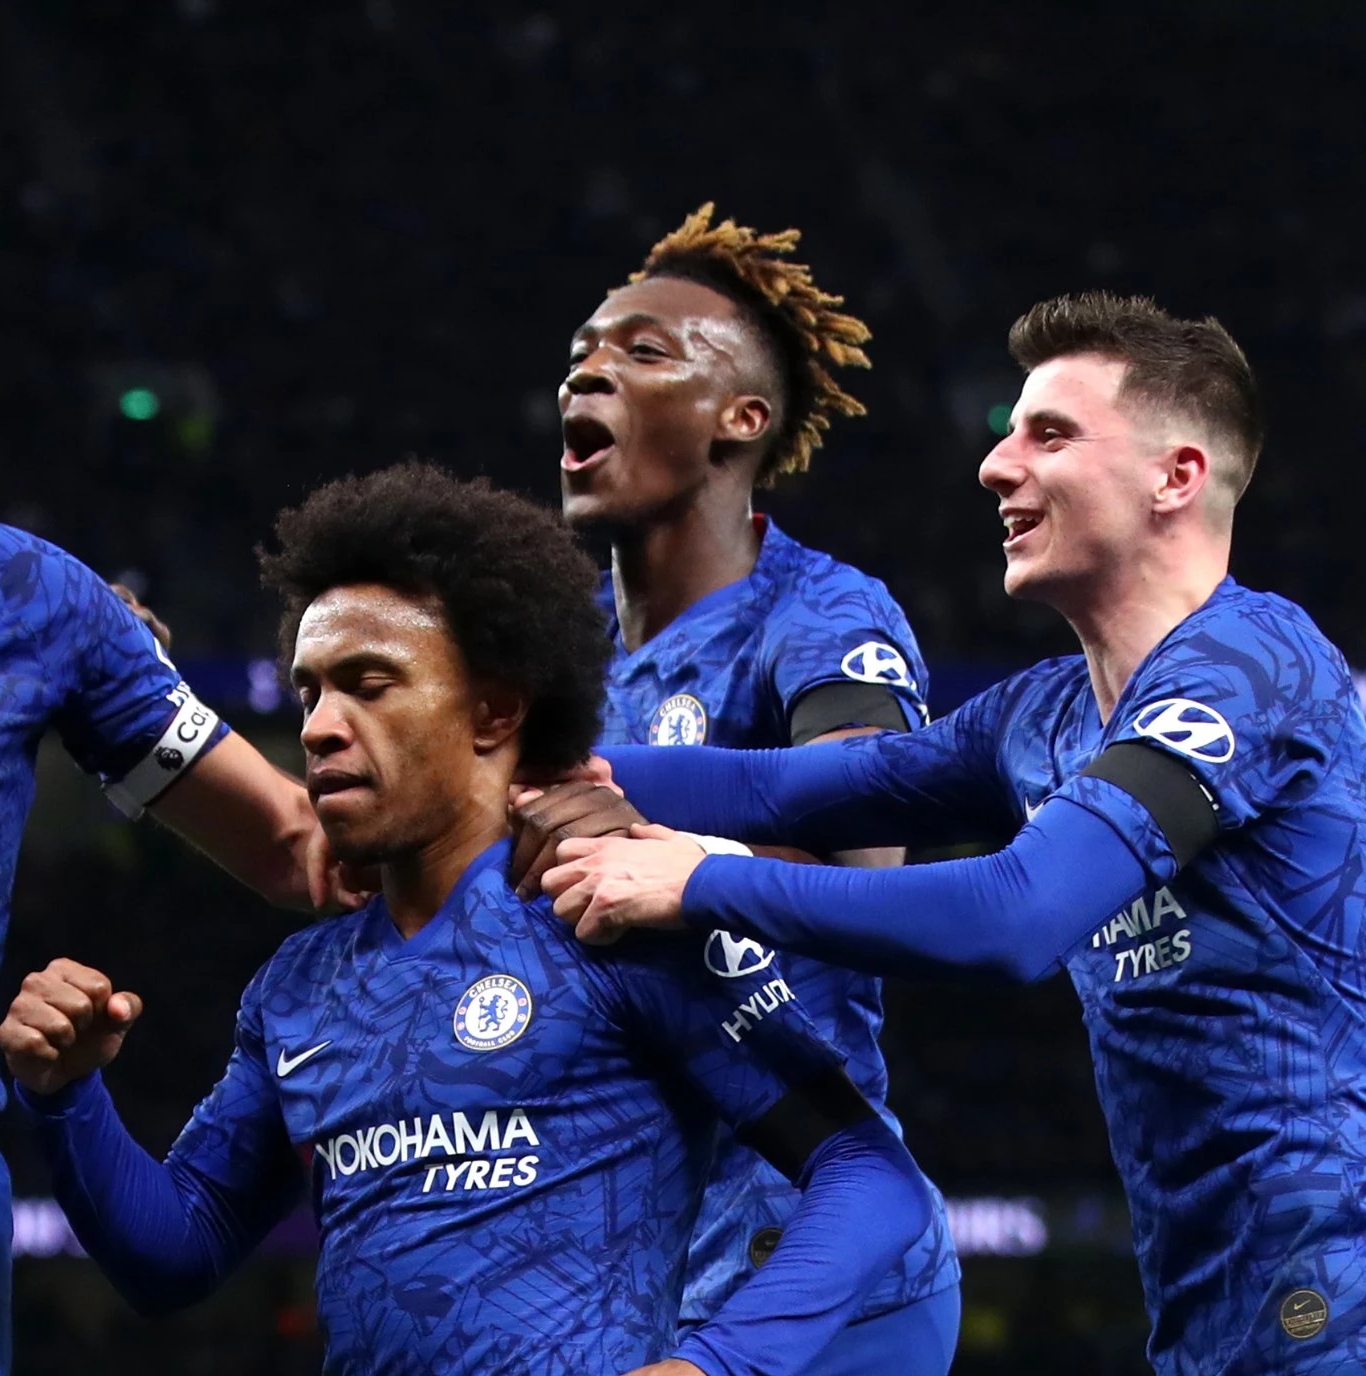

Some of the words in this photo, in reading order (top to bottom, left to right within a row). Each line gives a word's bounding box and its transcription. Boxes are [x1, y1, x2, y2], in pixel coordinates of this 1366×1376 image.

[1114, 929, 1192, 982] TYRES
[468, 978, 519, 998] CHELSEA
[315, 1108, 540, 1180] YOKOHAMA
[422, 1155, 540, 1193] TYRES
